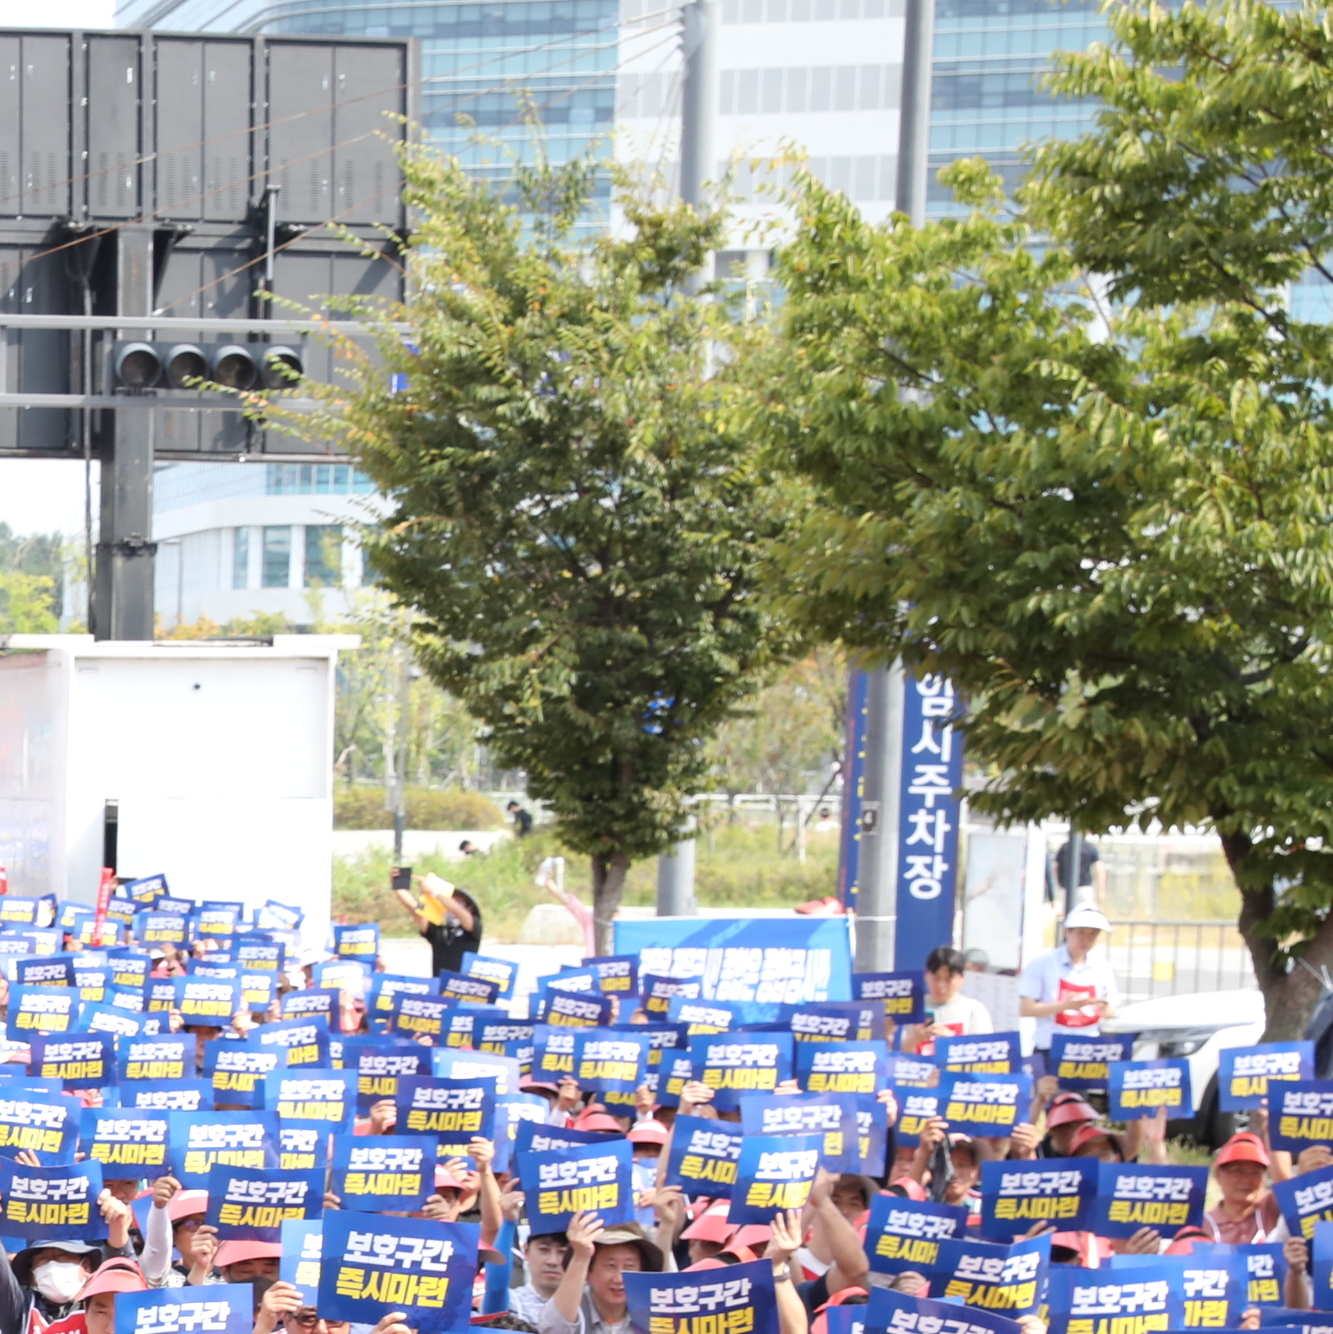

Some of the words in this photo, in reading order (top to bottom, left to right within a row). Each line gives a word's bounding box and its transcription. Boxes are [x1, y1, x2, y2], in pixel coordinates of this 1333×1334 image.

[903, 672, 954, 900] 임시주차장
[340, 929, 376, 948] 보호구간
[43, 1042, 103, 1062] 보호구간
[707, 1044, 778, 1066] 보호구간
[42, 1061, 102, 1079] 즉시마련
[703, 1069, 776, 1089] 즉시마련
[1123, 1066, 1181, 1090] 보호구간
[412, 1088, 484, 1109] 보호구간
[412, 1088, 484, 1109] 보호구간
[948, 1082, 1019, 1108] 보호구간
[1122, 1089, 1181, 1107] 즉시마련
[408, 1111, 482, 1131] 즉시마련
[408, 1111, 482, 1131] 즉시마련
[947, 1103, 1016, 1124] 즉시마련
[540, 1156, 618, 1188] 보호구간
[1000, 1171, 1081, 1195] 보호구간
[10, 1176, 89, 1200] 보호구간
[7, 1201, 89, 1224] 즉시마련
[540, 1184, 618, 1220] 즉시마련
[996, 1197, 1079, 1219] 즉시마련
[345, 1232, 453, 1271] 보호구간
[337, 1268, 448, 1307] 즉시마련
[651, 1279, 751, 1313] 보호구간
[135, 1301, 231, 1334] 보호구간
